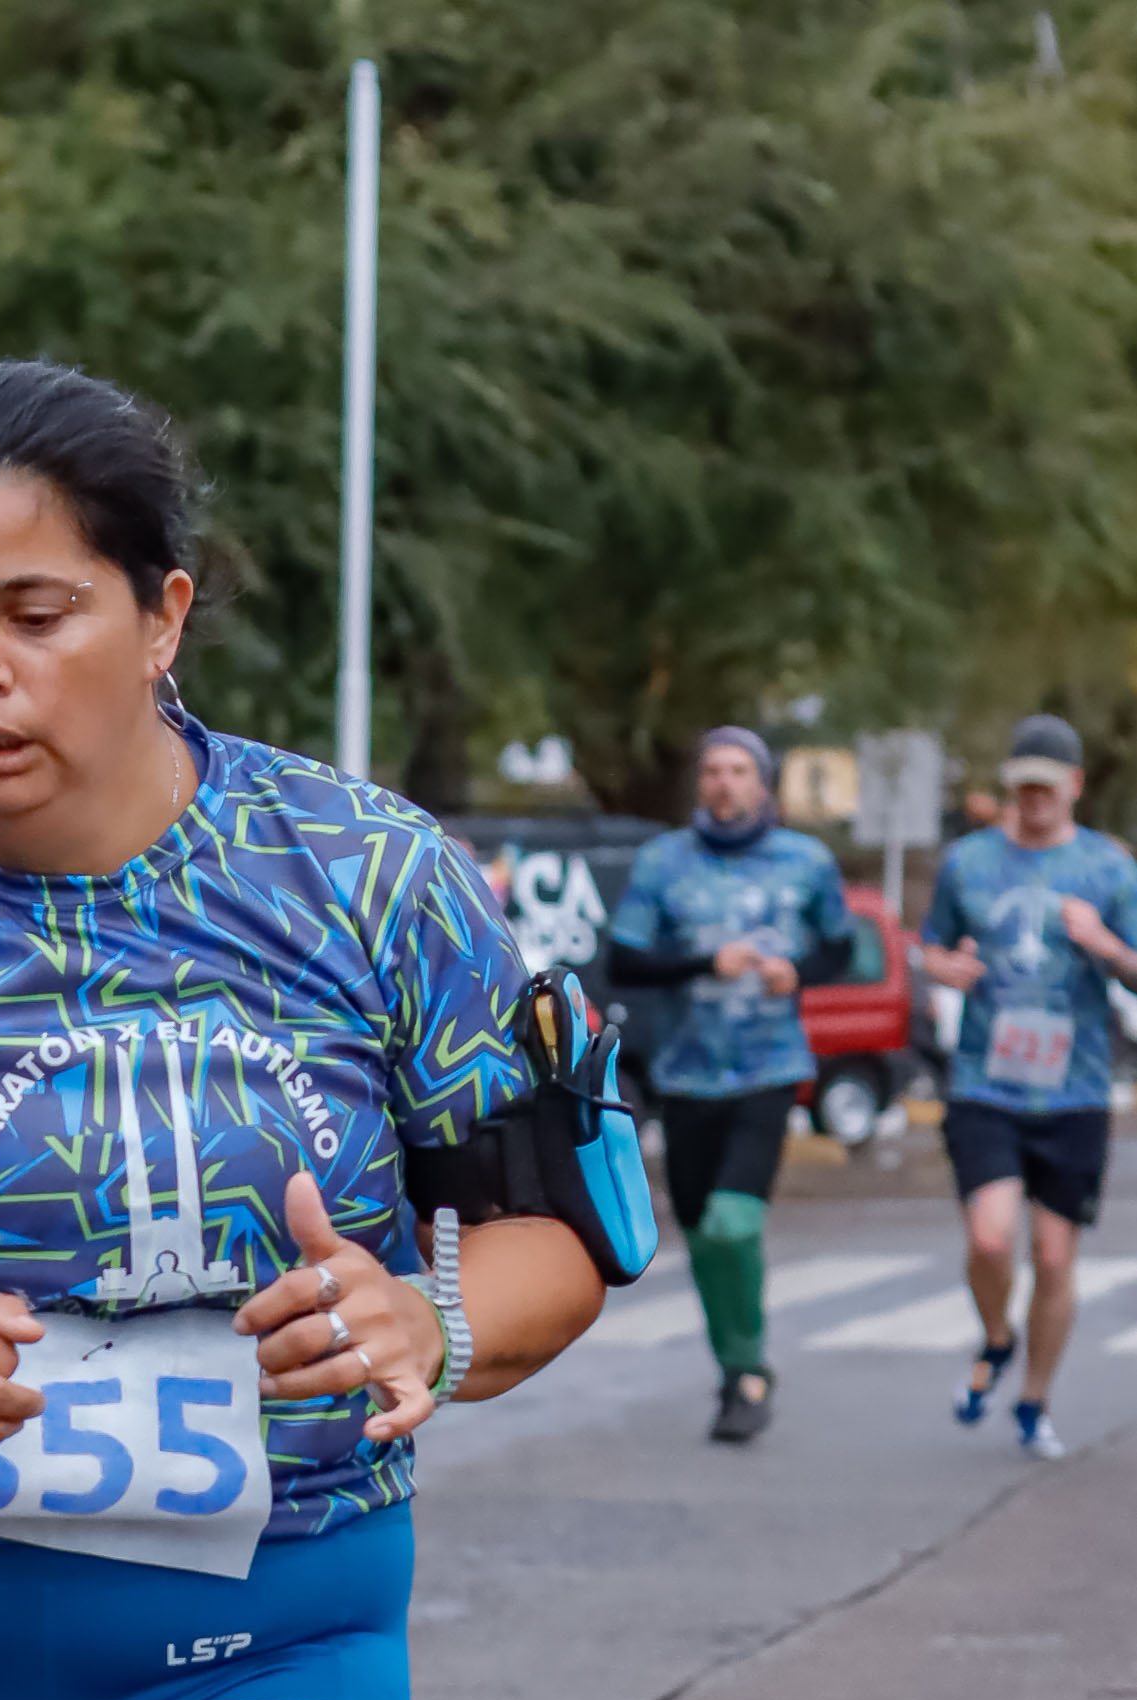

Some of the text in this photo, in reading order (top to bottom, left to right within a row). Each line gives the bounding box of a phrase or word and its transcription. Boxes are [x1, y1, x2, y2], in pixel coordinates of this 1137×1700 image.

[115, 1022, 145, 1042] X
[156, 1020, 199, 1043] EL
[209, 1030, 340, 1160] AUTISMO
[167, 1632, 252, 1667] LSP
